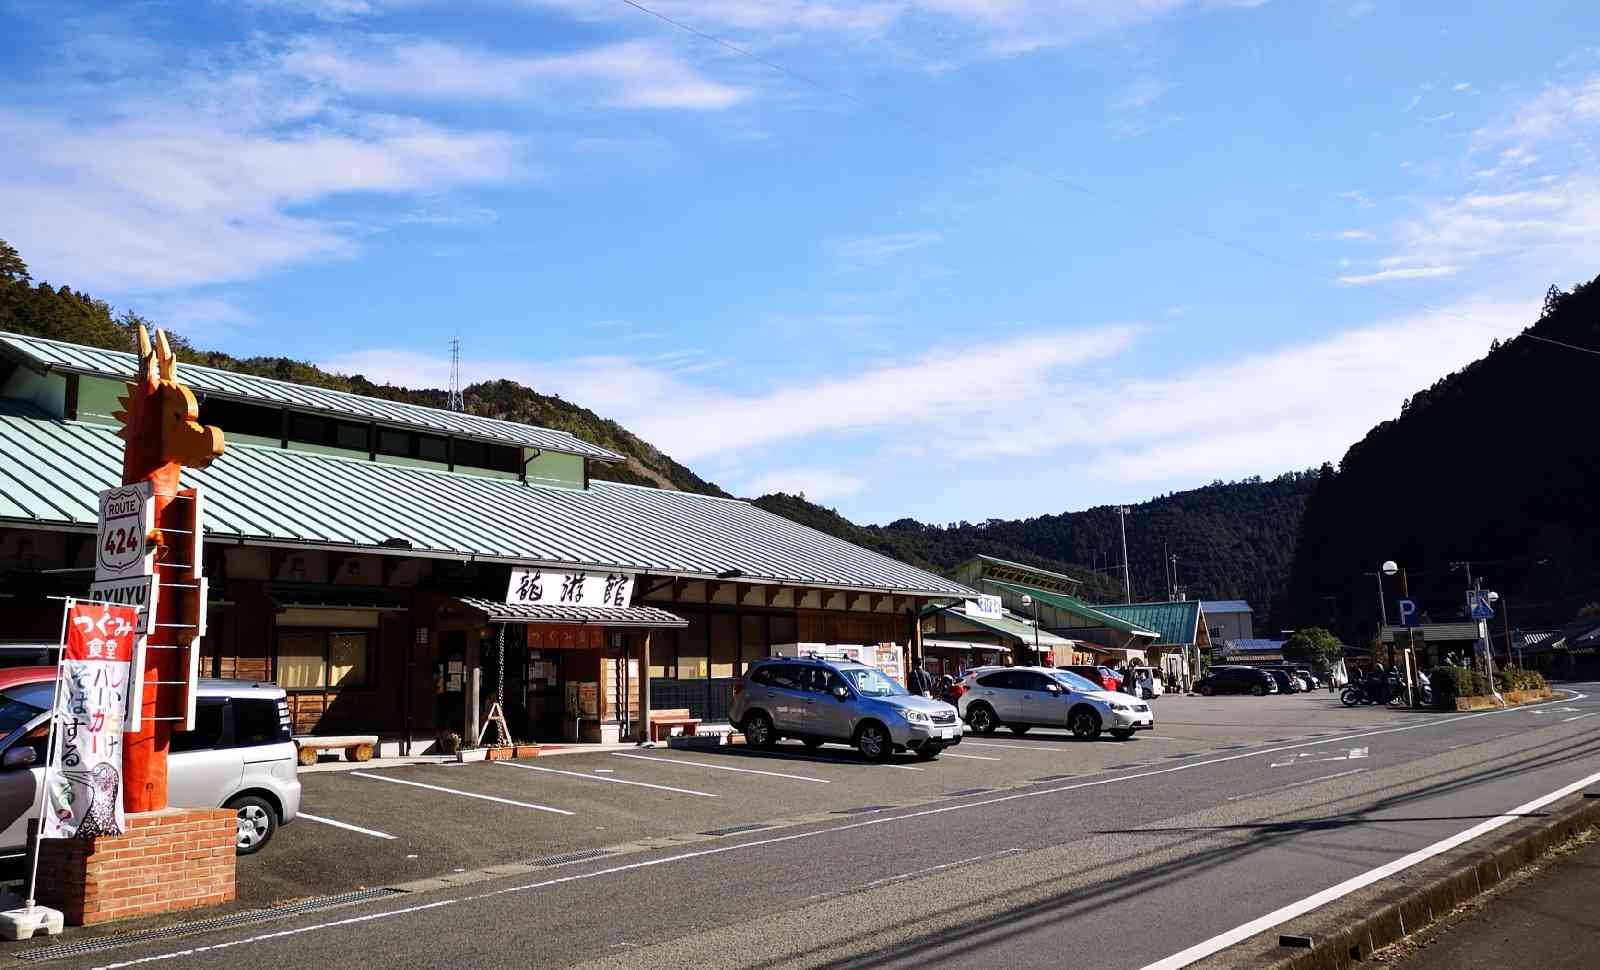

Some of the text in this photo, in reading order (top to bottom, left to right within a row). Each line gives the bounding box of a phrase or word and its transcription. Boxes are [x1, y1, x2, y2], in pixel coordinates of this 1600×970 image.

[108, 500, 136, 515] ROUTE
[104, 526, 138, 555] 424
[93, 584, 147, 605] RYUYU
[73, 612, 133, 637] つぐみ
[1400, 600, 1416, 625] P
[86, 637, 118, 659] 食堂
[87, 663, 108, 754] バーガー
